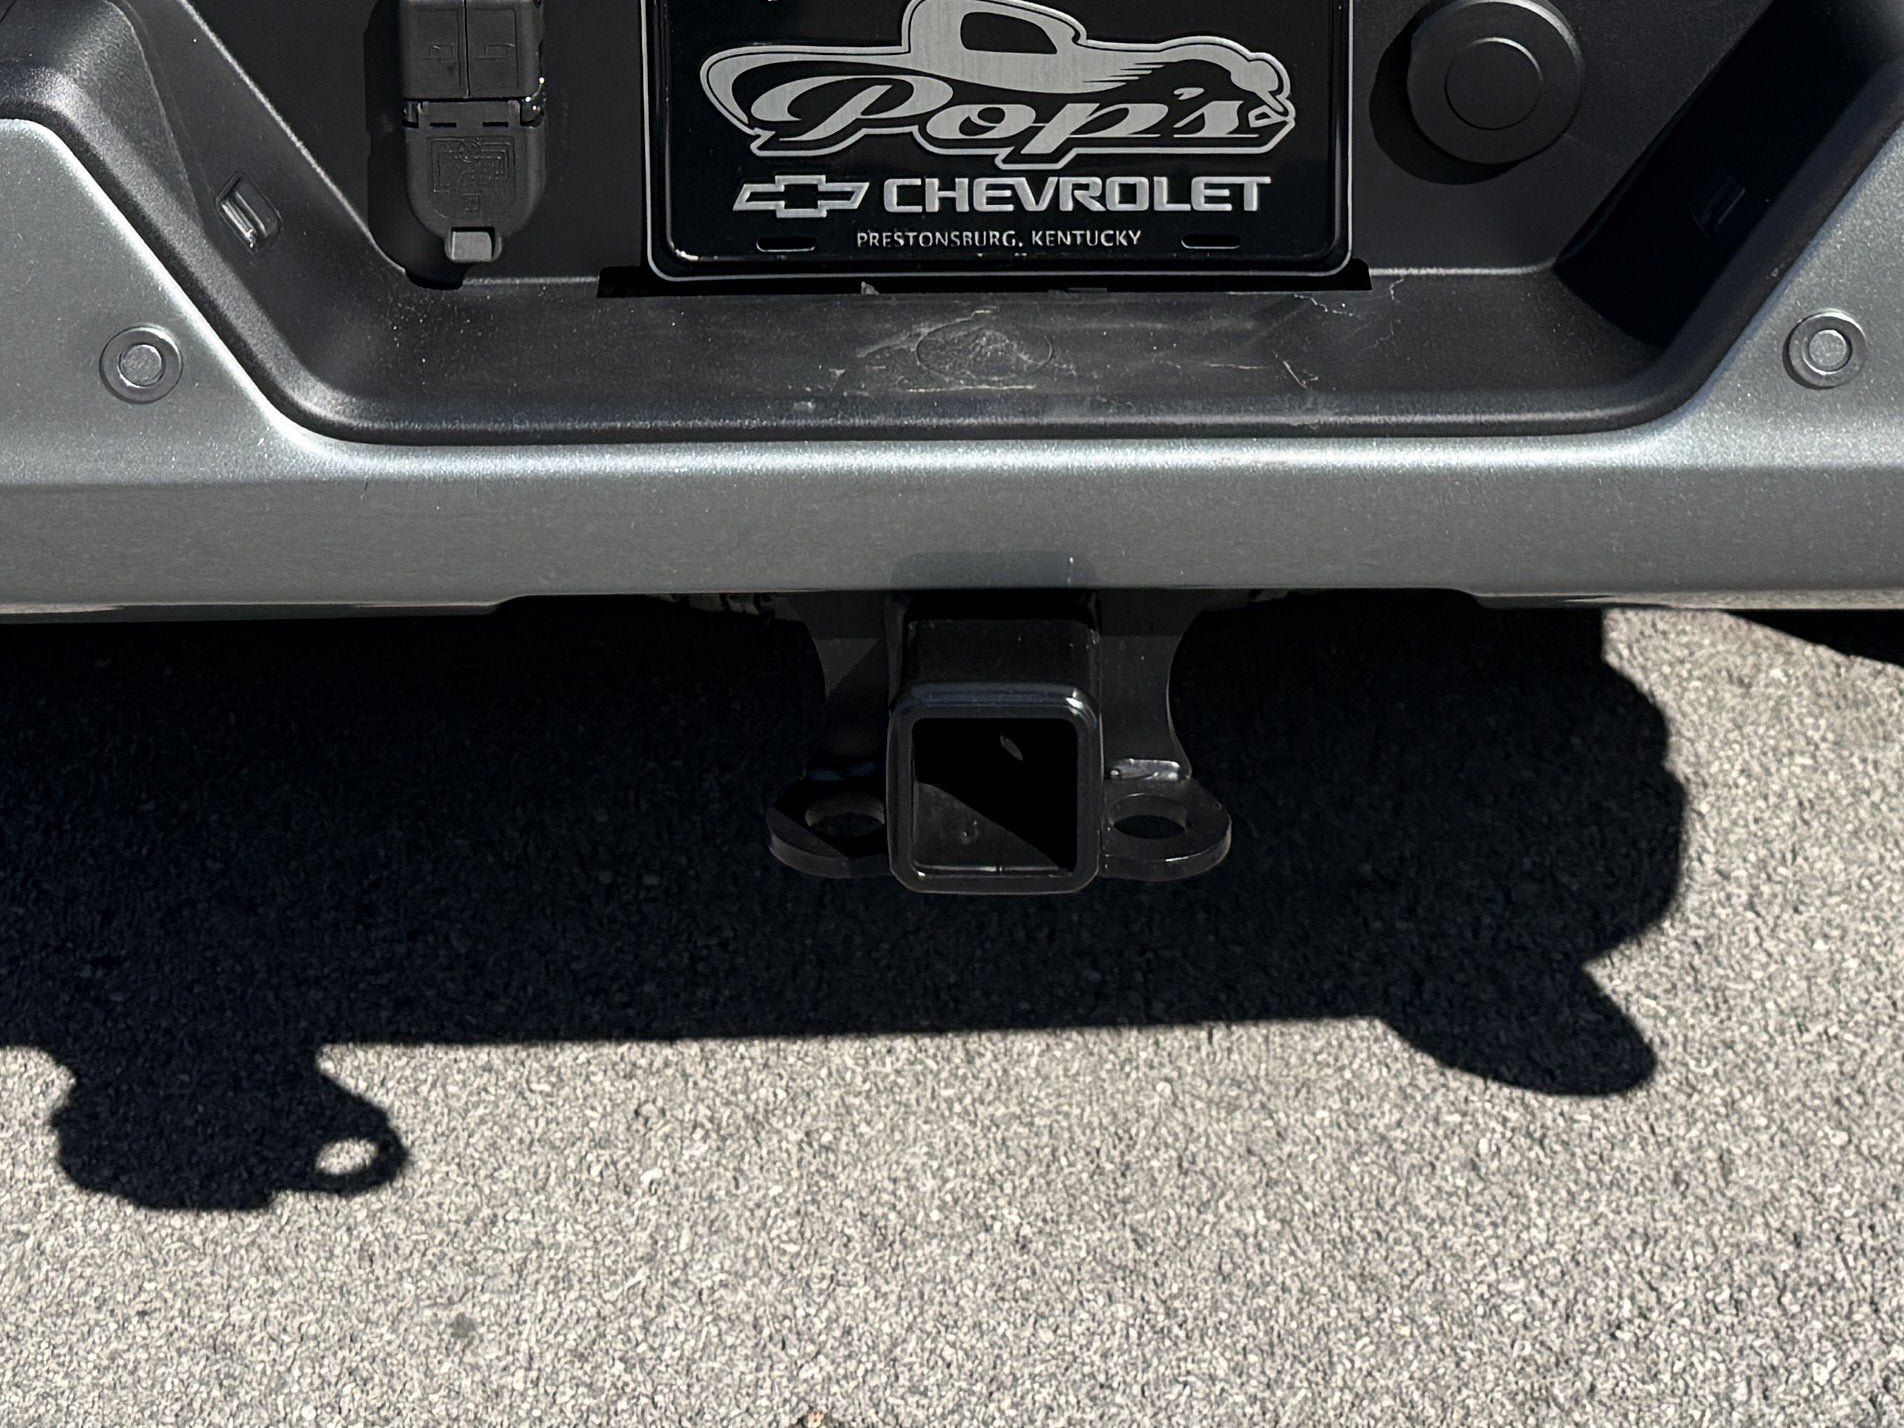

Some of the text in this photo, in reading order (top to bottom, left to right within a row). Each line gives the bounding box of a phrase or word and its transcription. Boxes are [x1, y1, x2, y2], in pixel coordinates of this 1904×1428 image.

[750, 74, 1266, 157] Pop's
[883, 175, 1272, 213] CHEVROLET
[1031, 229, 1142, 247] KENTUCKY
